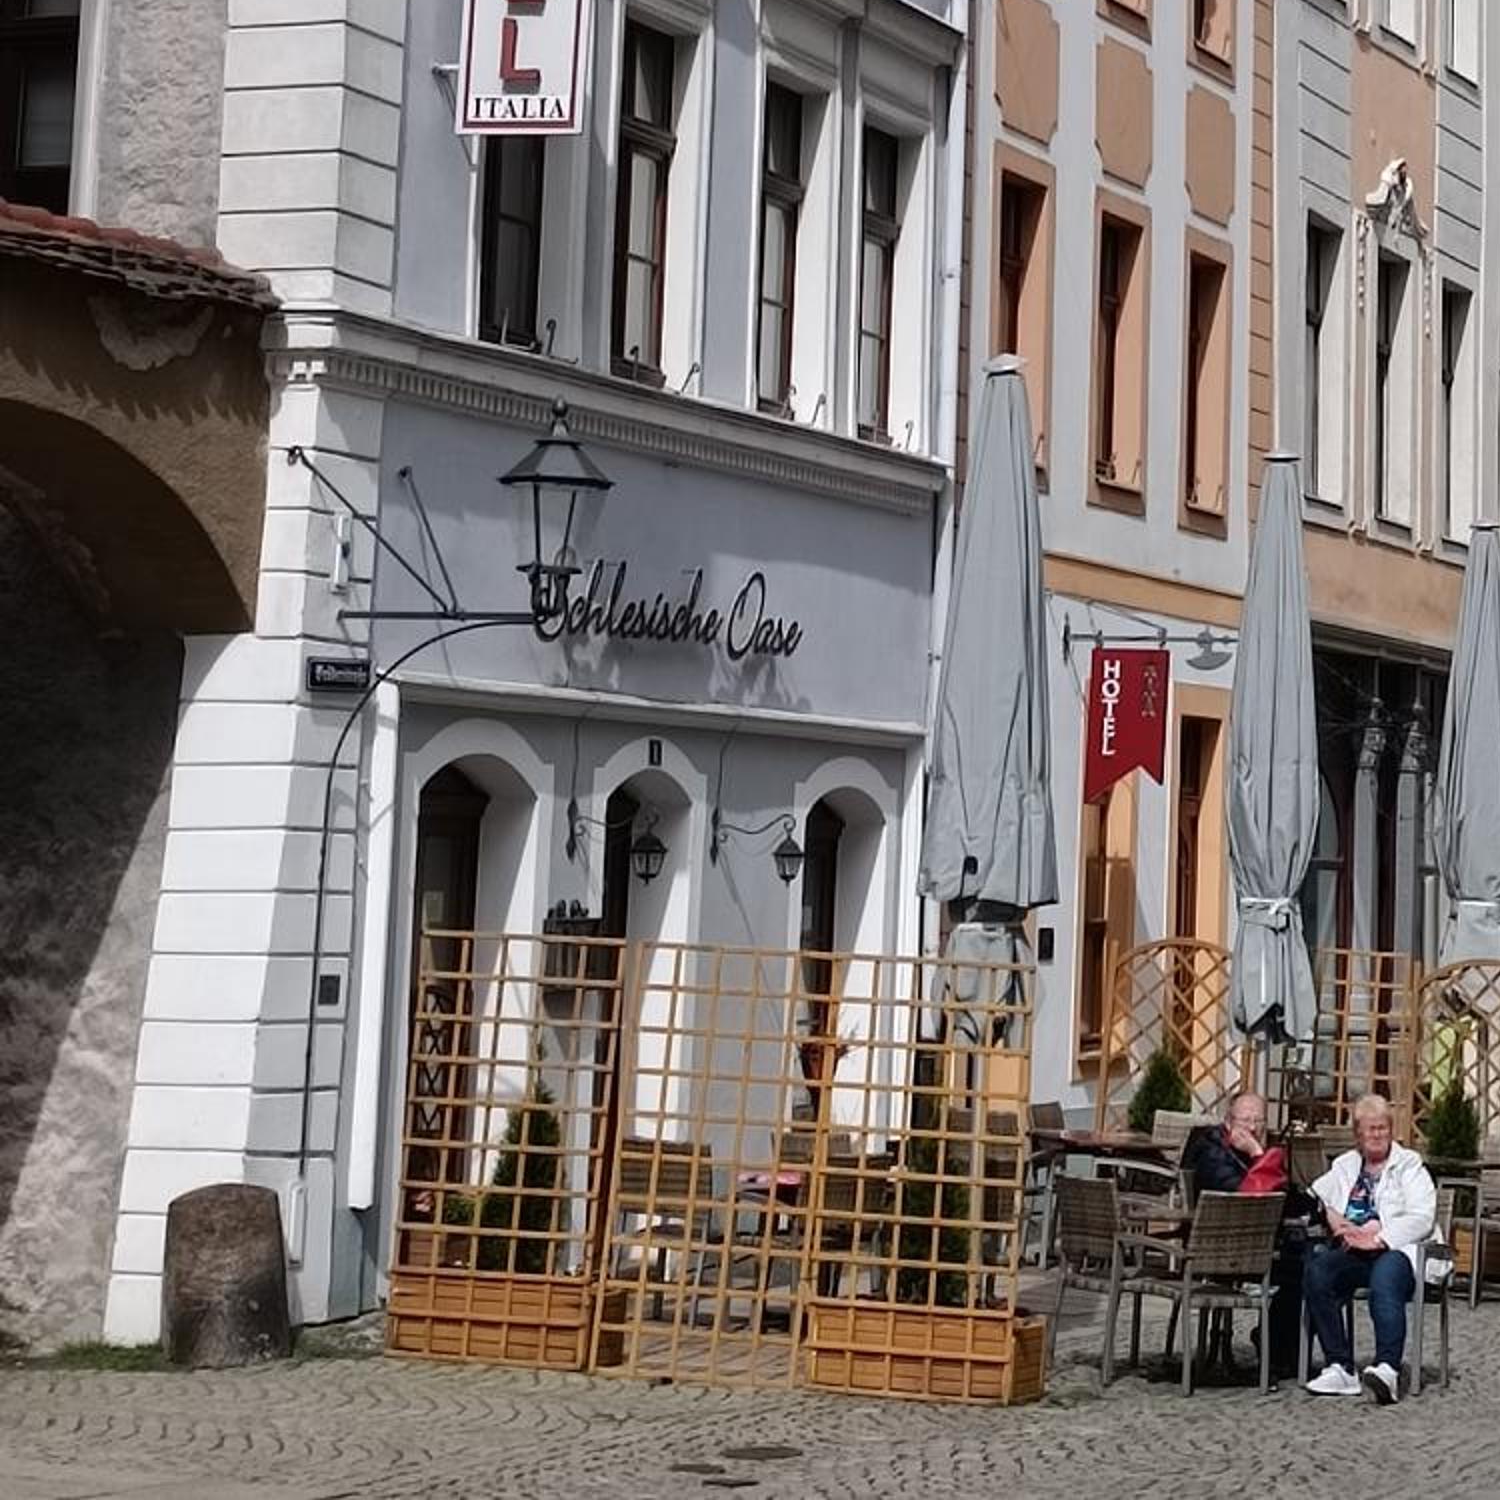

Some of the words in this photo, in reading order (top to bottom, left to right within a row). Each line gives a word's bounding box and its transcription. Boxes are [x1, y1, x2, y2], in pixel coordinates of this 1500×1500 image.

[473, 97, 565, 119] ITALIA
[727, 571, 802, 660] Oase
[1101, 660, 1120, 756] HOTEL
